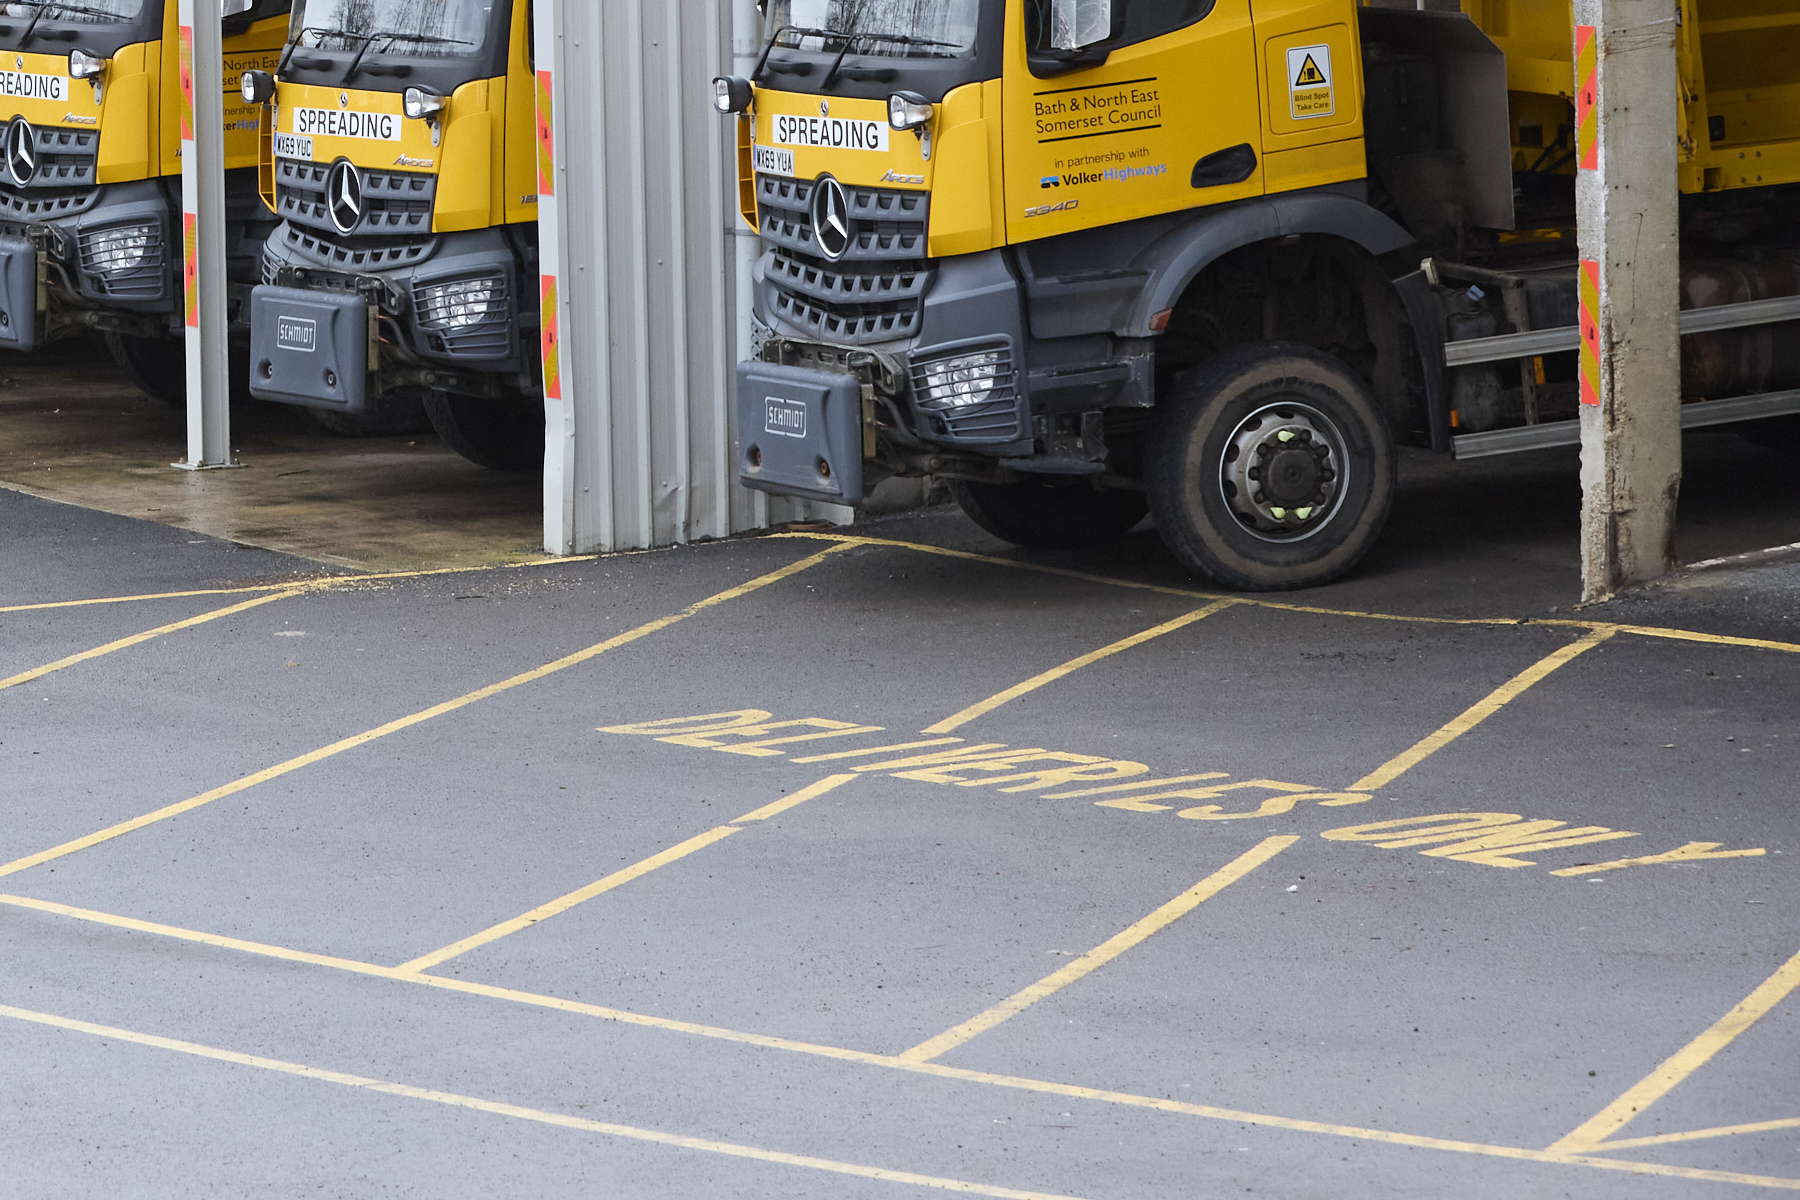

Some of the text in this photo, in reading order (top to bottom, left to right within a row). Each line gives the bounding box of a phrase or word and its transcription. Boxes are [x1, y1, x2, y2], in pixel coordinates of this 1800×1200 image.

[223, 57, 280, 71] North Eas
[1034, 89, 1159, 116] Bath & North East
[1294, 92, 1329, 101] Blind Spot
[1297, 103, 1312, 111] Take
[299, 109, 392, 139] SPREADING
[1036, 104, 1162, 134] Somerset Council
[779, 116, 879, 149] SPREADING
[277, 135, 312, 157] WX69 YUC
[756, 148, 793, 173] WX69 YUA
[1054, 147, 1149, 169] in partnership with
[1062, 163, 1167, 186] VolkerHighways
[1024, 199, 1079, 218] 3340
[280, 324, 314, 344] SCHMIDT
[768, 406, 804, 428] SCHMIDT
[595, 709, 1767, 877] DELIVERIES ONLY
